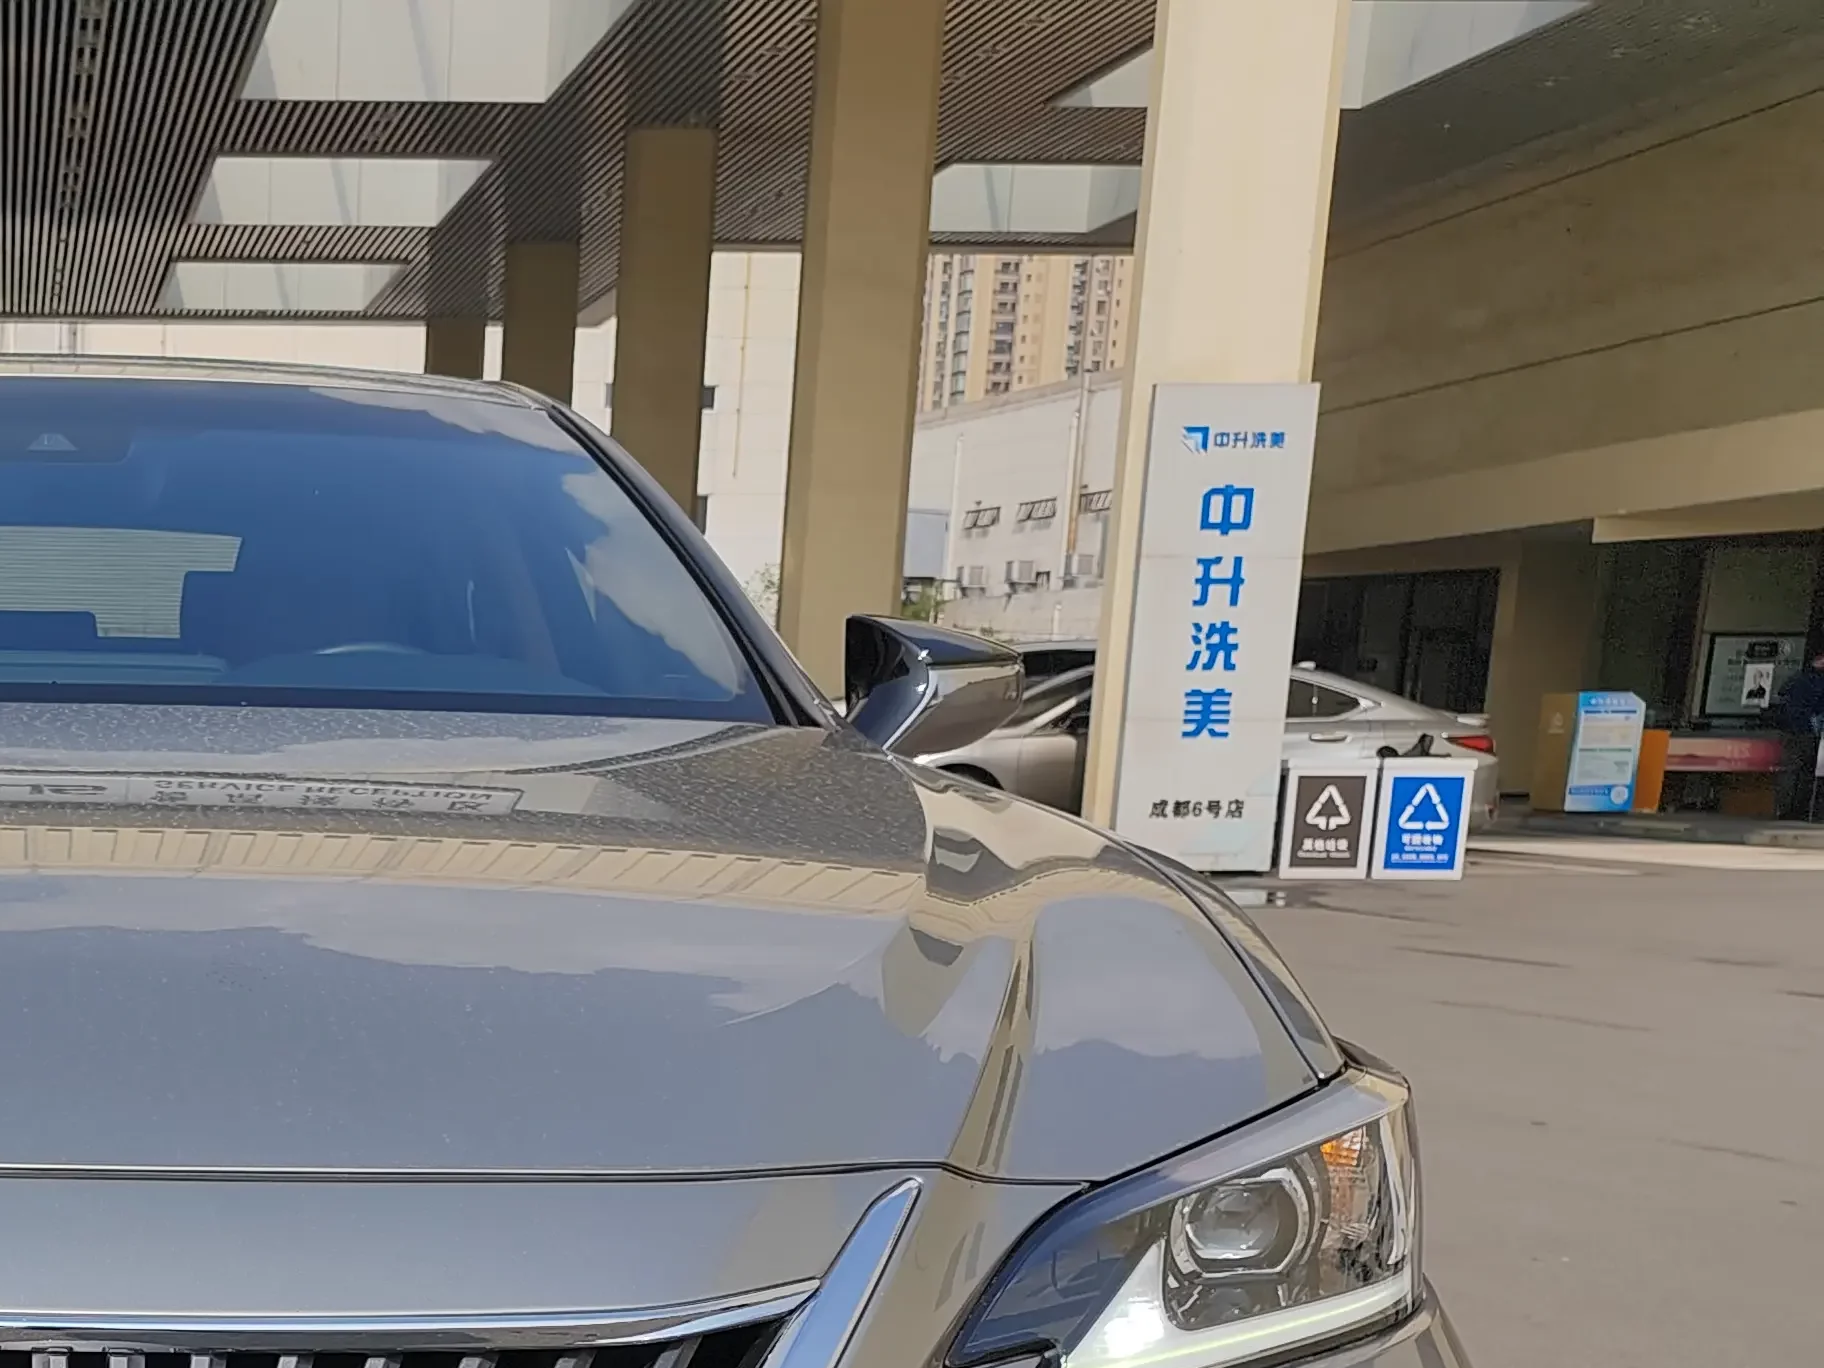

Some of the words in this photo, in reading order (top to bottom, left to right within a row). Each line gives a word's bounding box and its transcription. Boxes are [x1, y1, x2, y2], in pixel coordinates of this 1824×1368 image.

[1213, 431, 1285, 449] 中升洗美
[1180, 484, 1255, 739] 中升洗美
[1149, 799, 1244, 819] 成都6号店
